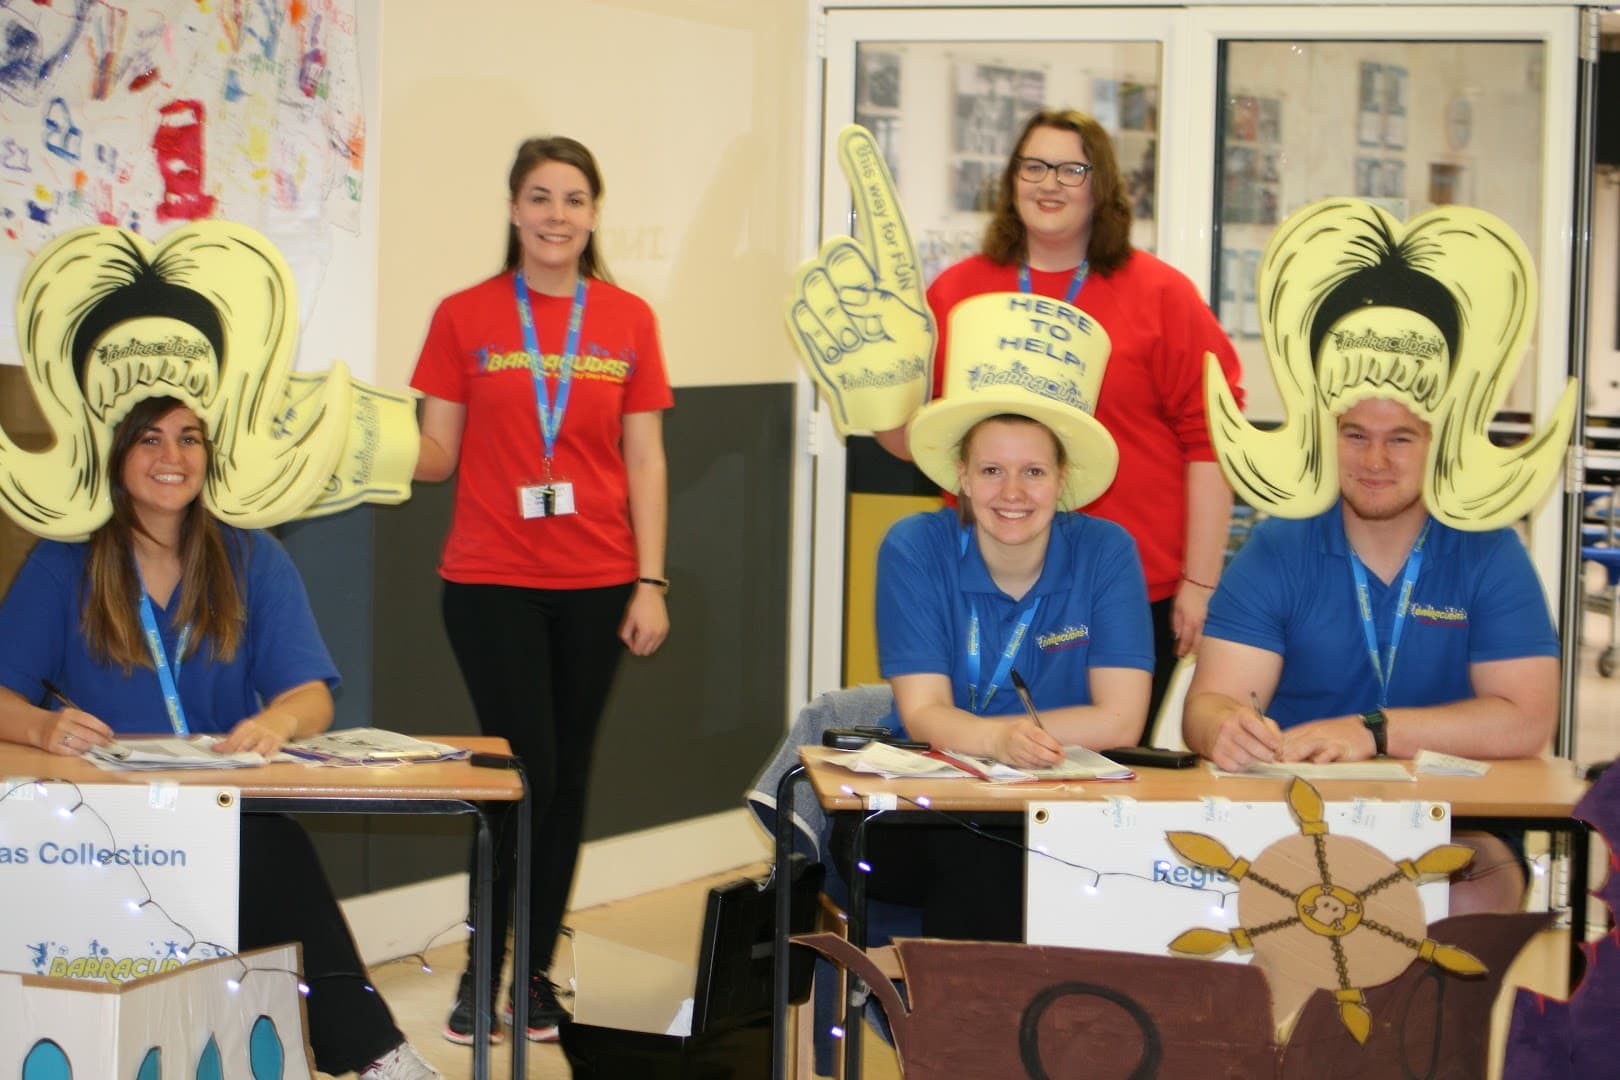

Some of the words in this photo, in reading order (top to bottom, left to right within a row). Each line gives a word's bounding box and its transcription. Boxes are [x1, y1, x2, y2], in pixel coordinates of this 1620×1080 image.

[855, 144, 877, 178] this
[869, 184, 887, 217] way
[882, 221, 899, 247] for
[891, 251, 914, 290] FUN
[1009, 298, 1093, 337] HERE
[1029, 318, 1071, 342] TO
[999, 336, 1086, 377] HELP!
[38, 842, 187, 867] Collection
